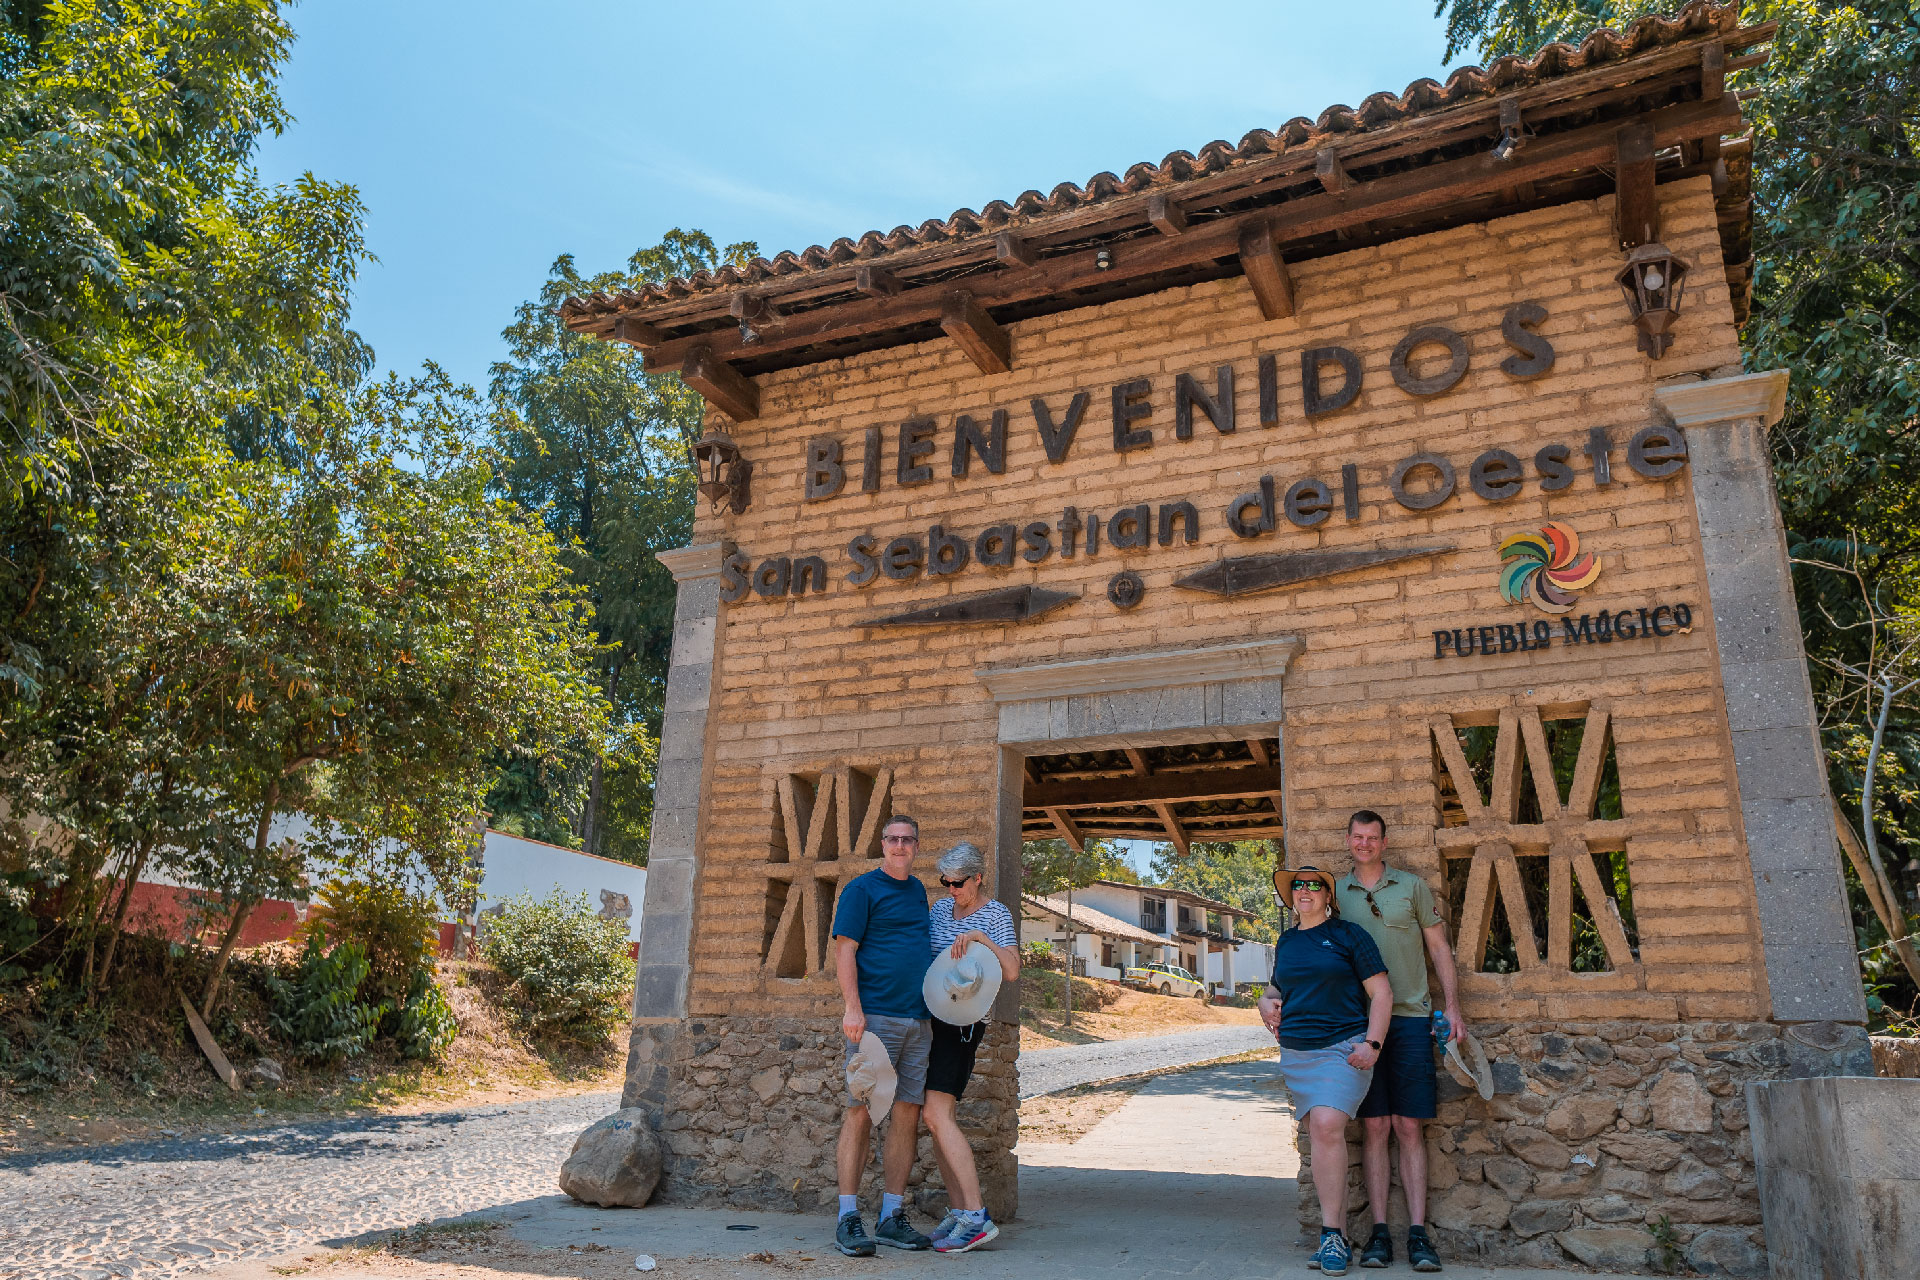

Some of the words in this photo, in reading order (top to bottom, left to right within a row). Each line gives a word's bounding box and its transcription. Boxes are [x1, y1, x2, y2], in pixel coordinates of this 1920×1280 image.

[805, 303, 1555, 502] BIENVENIDOS
[719, 551, 827, 603] San
[845, 501, 1199, 587] Sebastian
[1227, 463, 1360, 537] del
[1391, 425, 1688, 510] Oeste
[1432, 619, 1550, 659] PUEBLO
